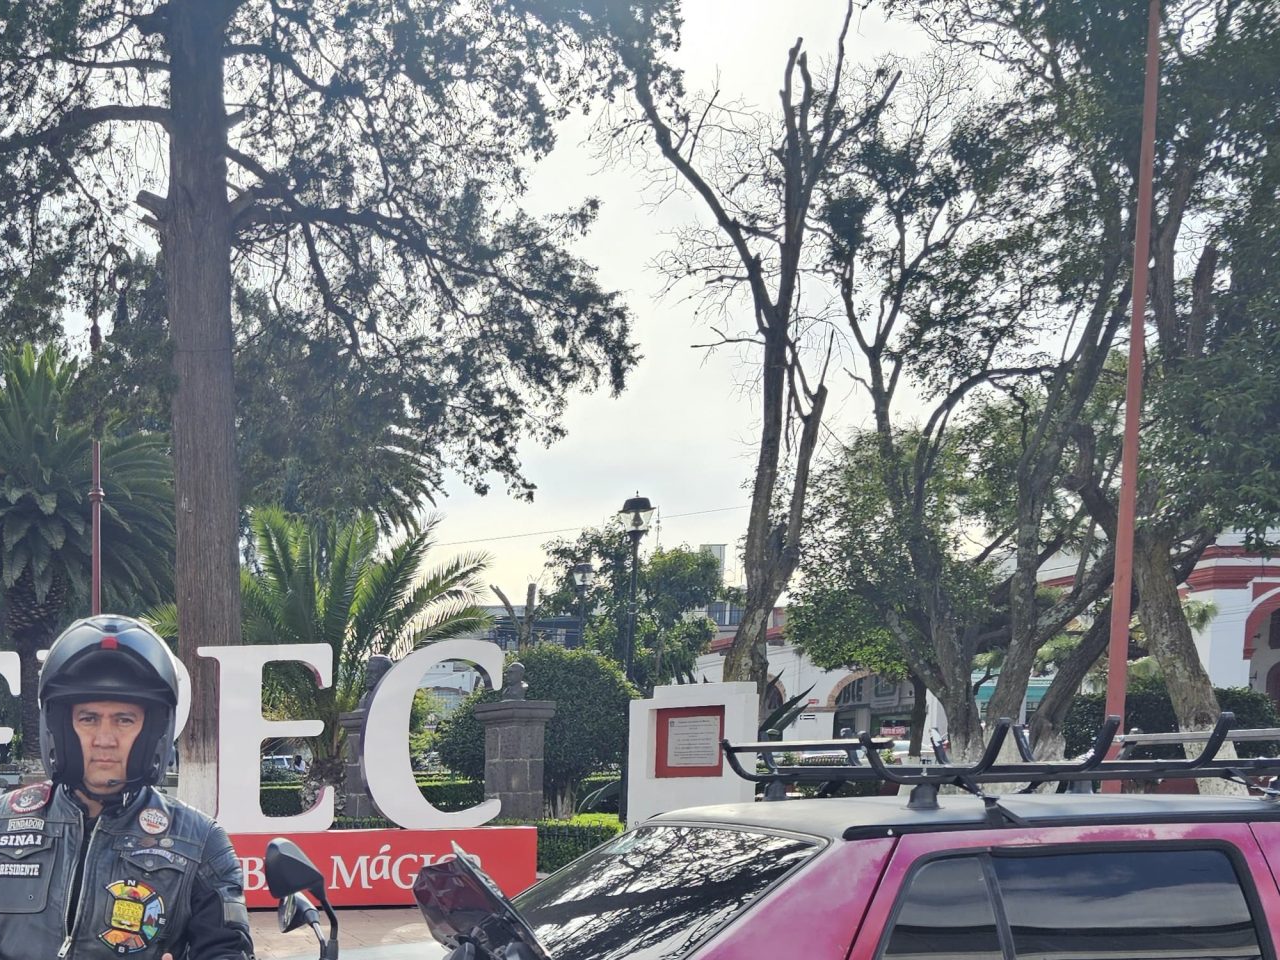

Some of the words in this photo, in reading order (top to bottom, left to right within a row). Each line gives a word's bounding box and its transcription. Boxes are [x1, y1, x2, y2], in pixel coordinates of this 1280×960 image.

[9, 819, 43, 830] FUNDADOR
[0, 833, 43, 847] SINAI
[127, 879, 136, 887] N
